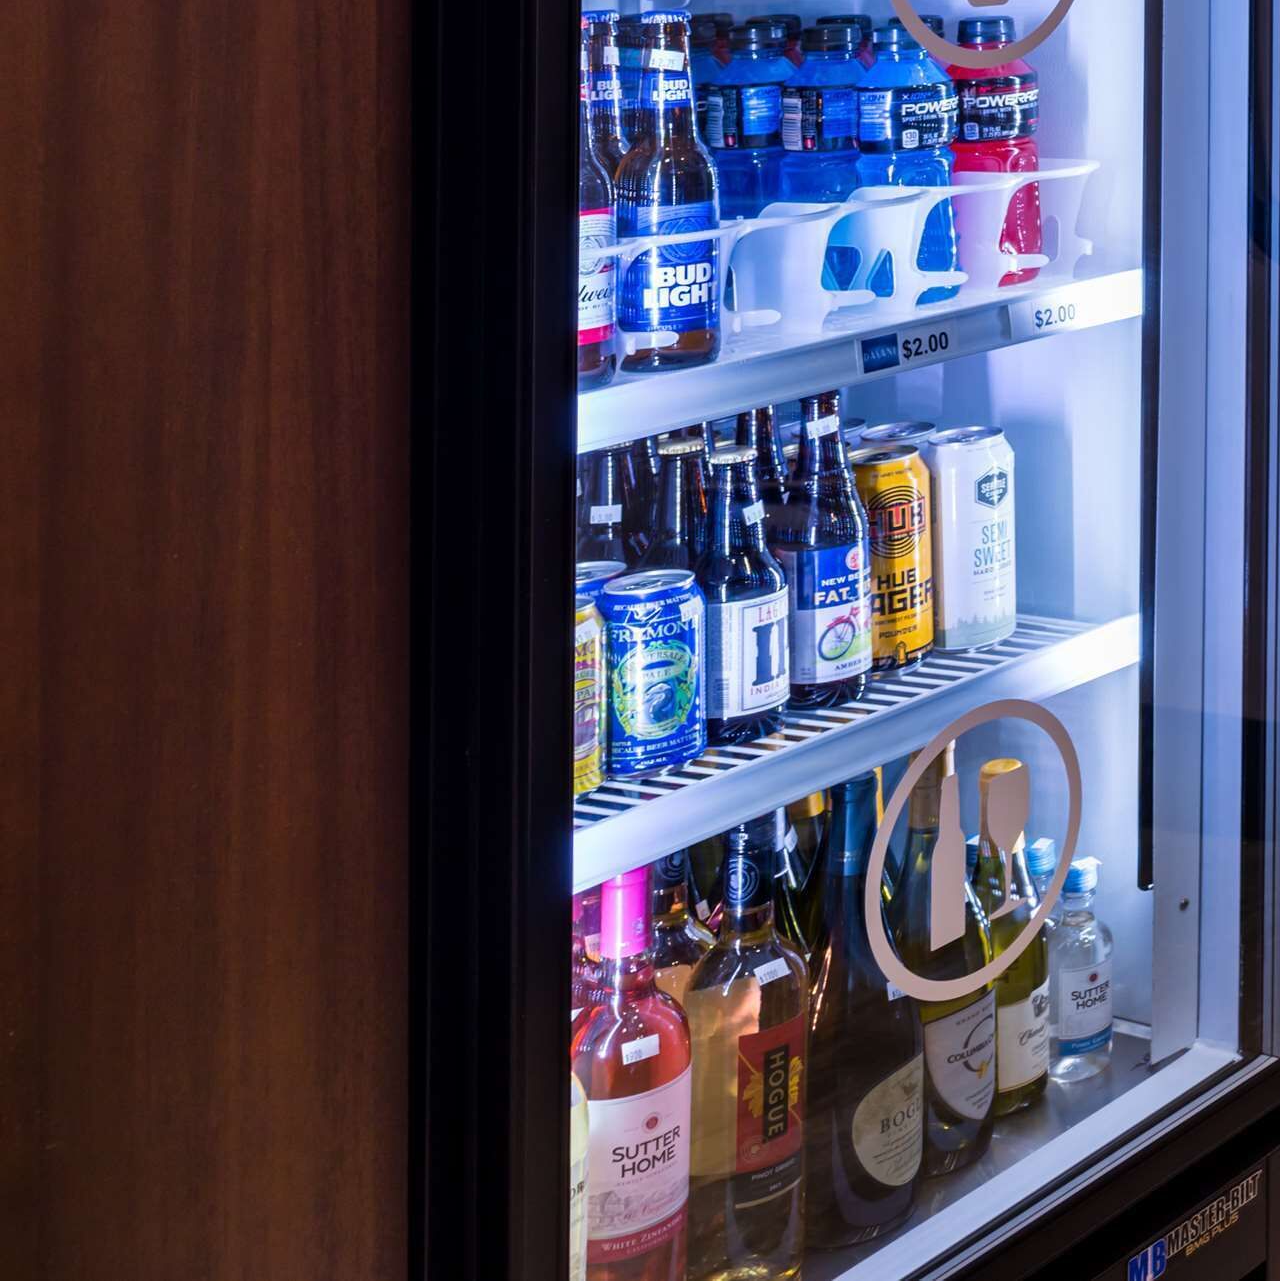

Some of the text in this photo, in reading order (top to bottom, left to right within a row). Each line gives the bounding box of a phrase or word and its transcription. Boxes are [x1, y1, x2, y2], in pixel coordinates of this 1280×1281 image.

[662, 79, 688, 91] BUD
[655, 262, 712, 288] BUD
[1034, 303, 1076, 329] $2.00
[902, 331, 949, 360] $2.00
[821, 576, 846, 587] NEW
[877, 567, 917, 591] HUB
[813, 587, 850, 606] FAT
[872, 577, 935, 616] AGER
[1071, 980, 1110, 1001] SUTTER
[1076, 991, 1108, 1010] HOME
[768, 1051, 785, 1137] HOGUE
[612, 1124, 680, 1163] SUTTER
[621, 1144, 676, 1179] HOME
[751, 1167, 775, 1181] PINOT
[1167, 1169, 1263, 1260] MASTER-BILT
[1211, 1210, 1240, 1239] PLUS
